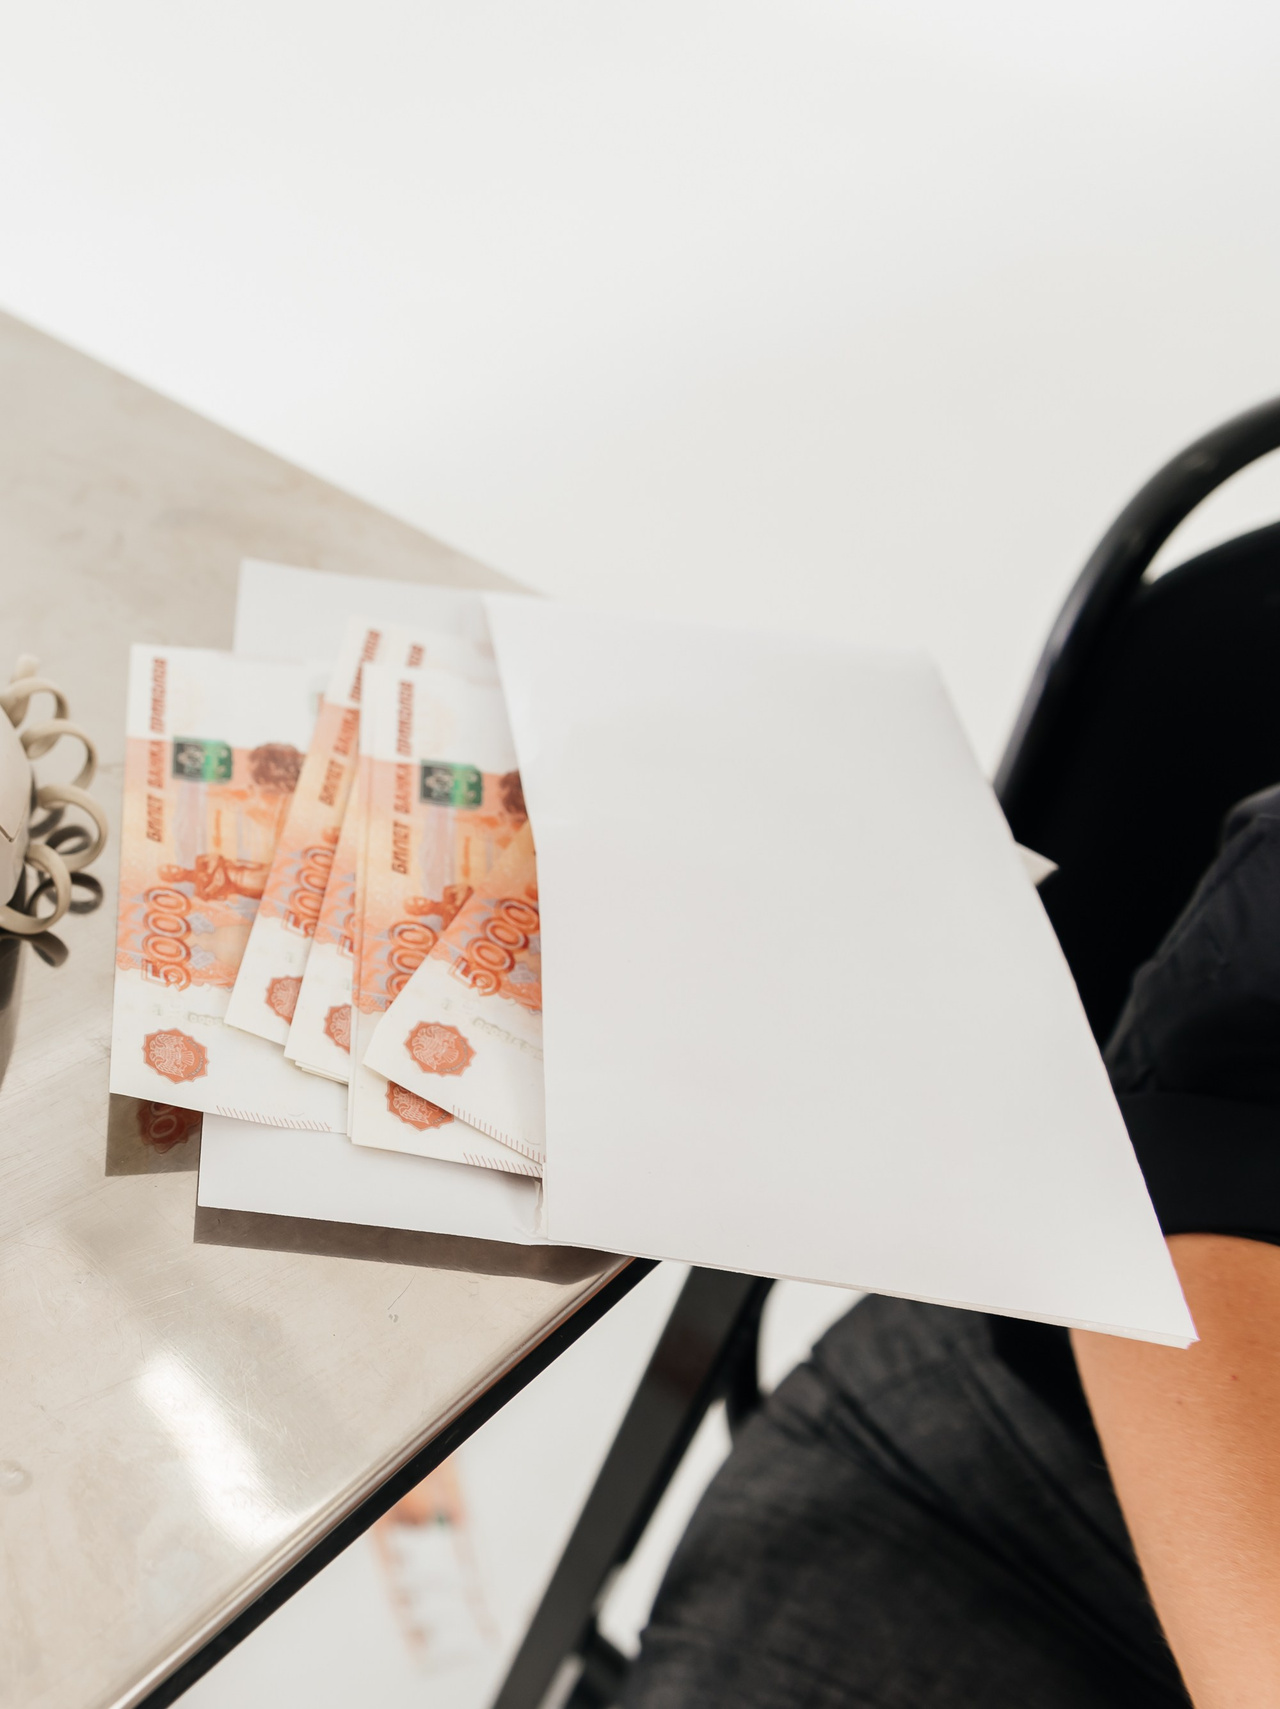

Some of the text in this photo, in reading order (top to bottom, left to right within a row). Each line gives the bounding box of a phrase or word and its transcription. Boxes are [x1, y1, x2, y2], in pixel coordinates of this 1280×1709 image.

[391, 820, 411, 875] БИЛЕТ
[141, 886, 192, 993] 5000
[448, 896, 541, 997] 5000
